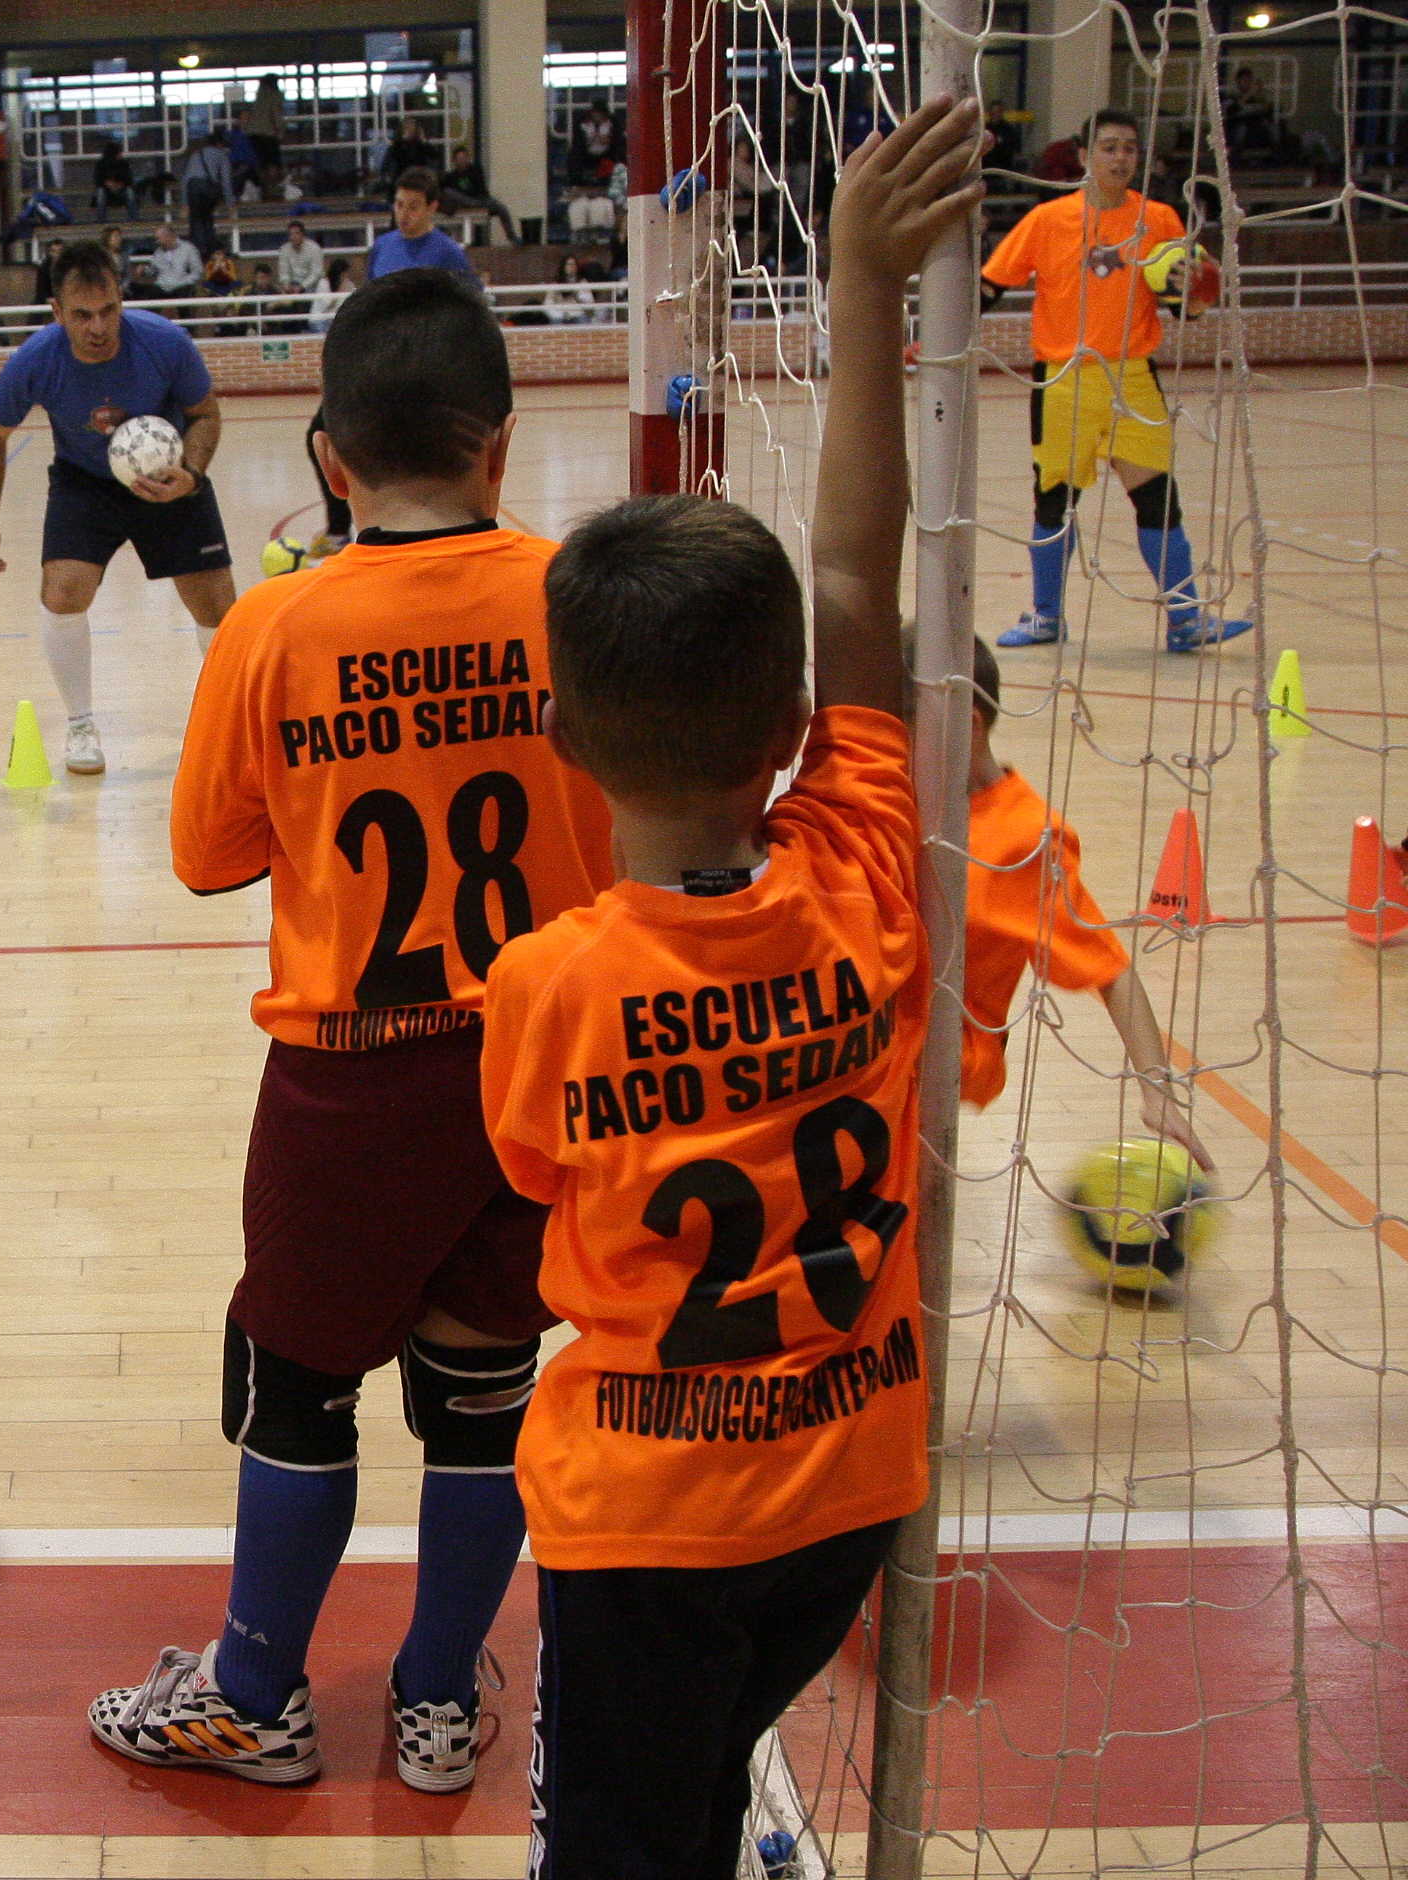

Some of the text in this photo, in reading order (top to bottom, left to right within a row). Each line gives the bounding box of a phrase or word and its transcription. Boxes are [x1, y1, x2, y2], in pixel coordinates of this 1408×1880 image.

[337, 639, 530, 704] ESCUELA
[278, 706, 401, 768] PACO
[334, 770, 533, 1010] 28
[620, 957, 872, 1060] ESCUELA
[564, 1062, 706, 1144] PACO
[640, 1095, 909, 1370] 28
